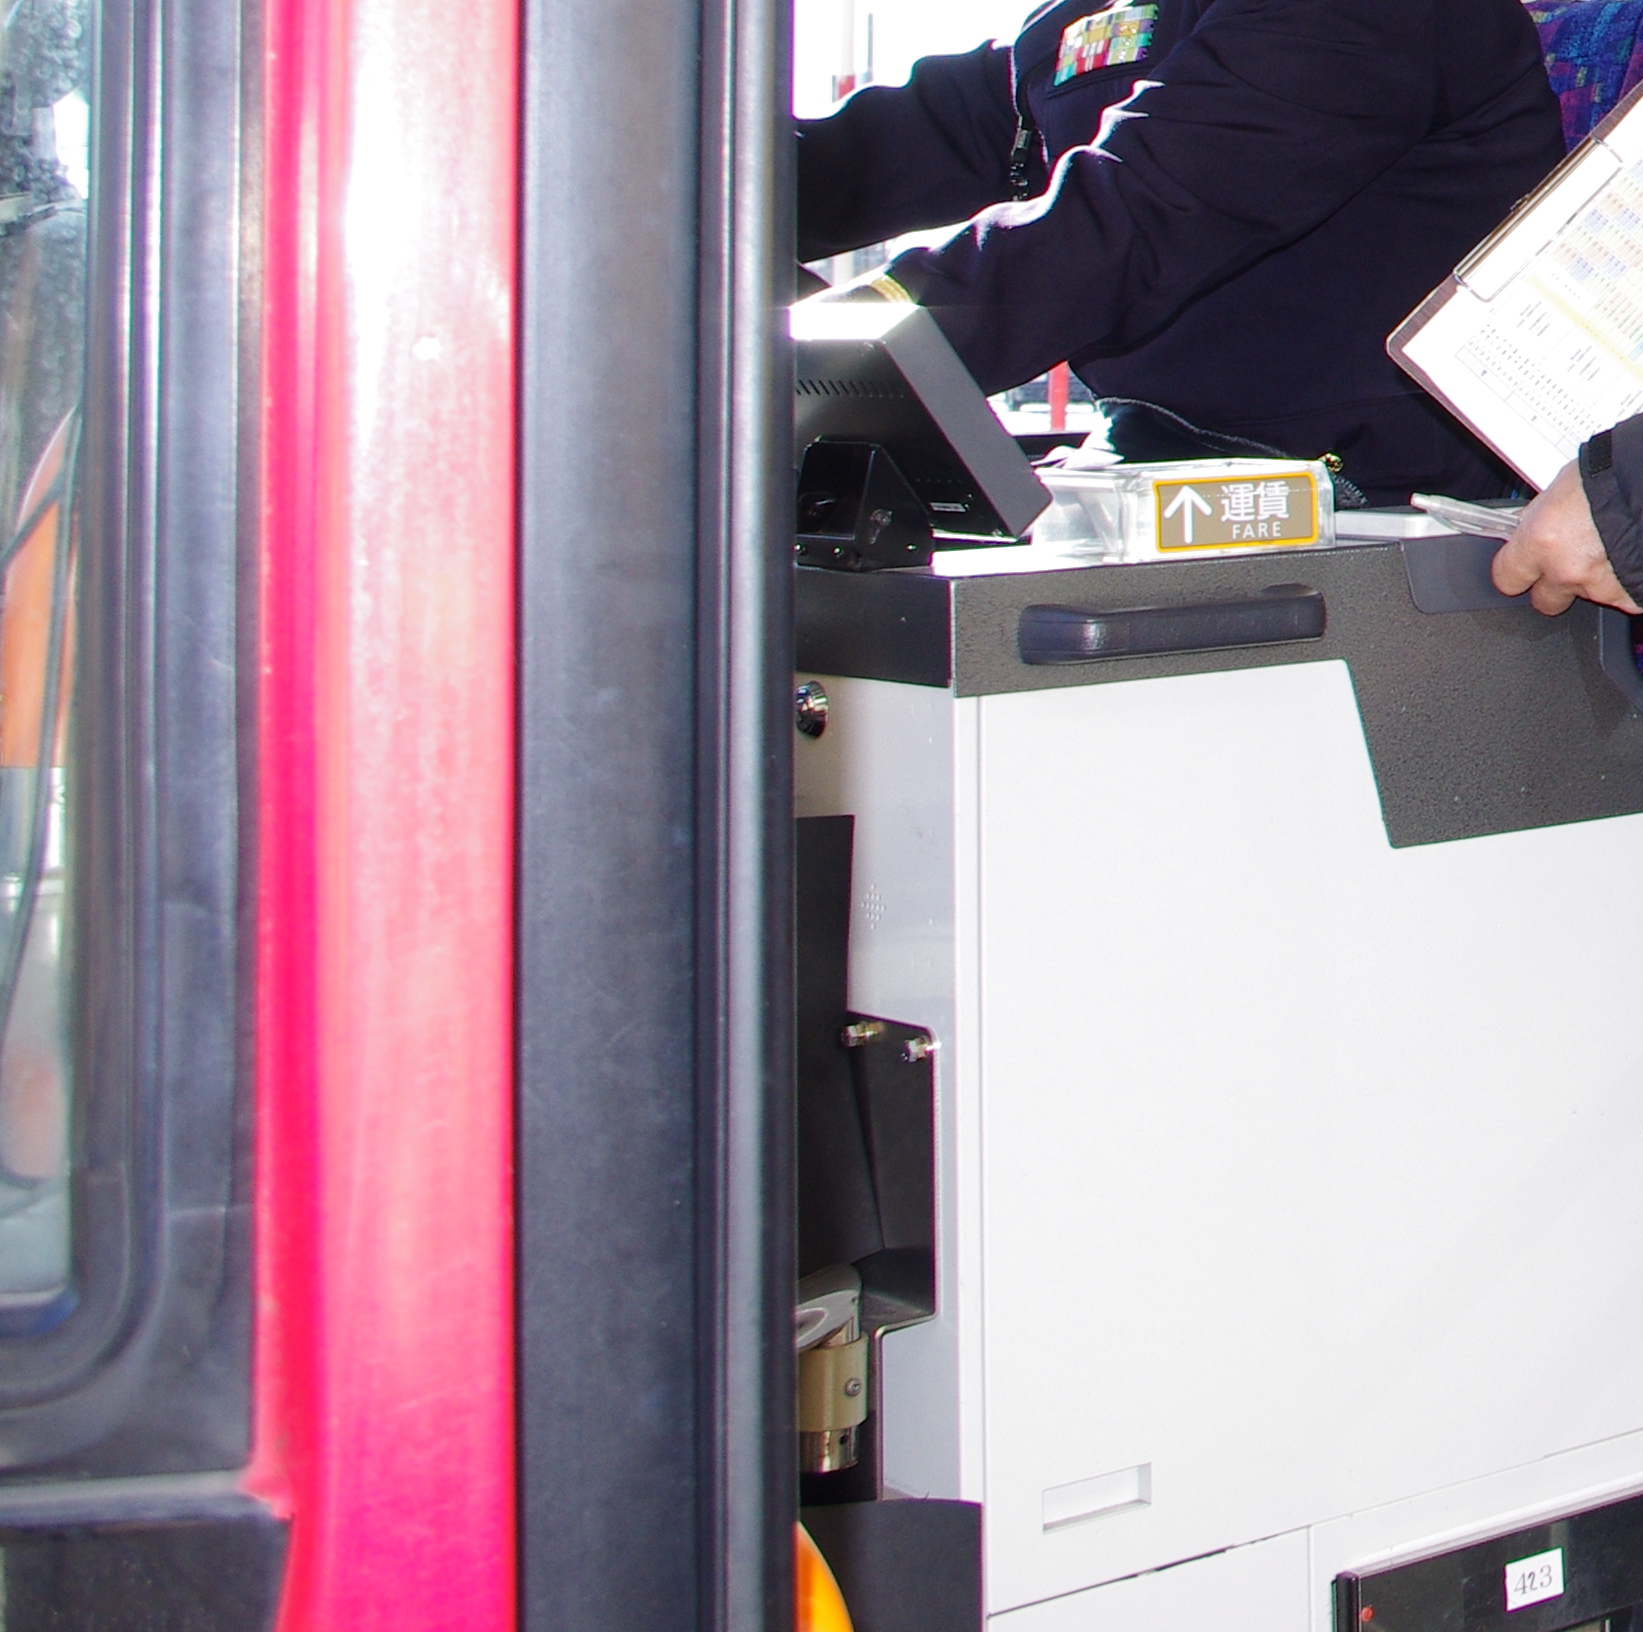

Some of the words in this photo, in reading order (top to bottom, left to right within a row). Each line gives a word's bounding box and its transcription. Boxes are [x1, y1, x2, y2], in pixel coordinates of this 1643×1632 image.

[1221, 480, 1290, 523] 運賃
[1231, 521, 1283, 540] FARE
[1513, 1565, 1553, 1596] 423
